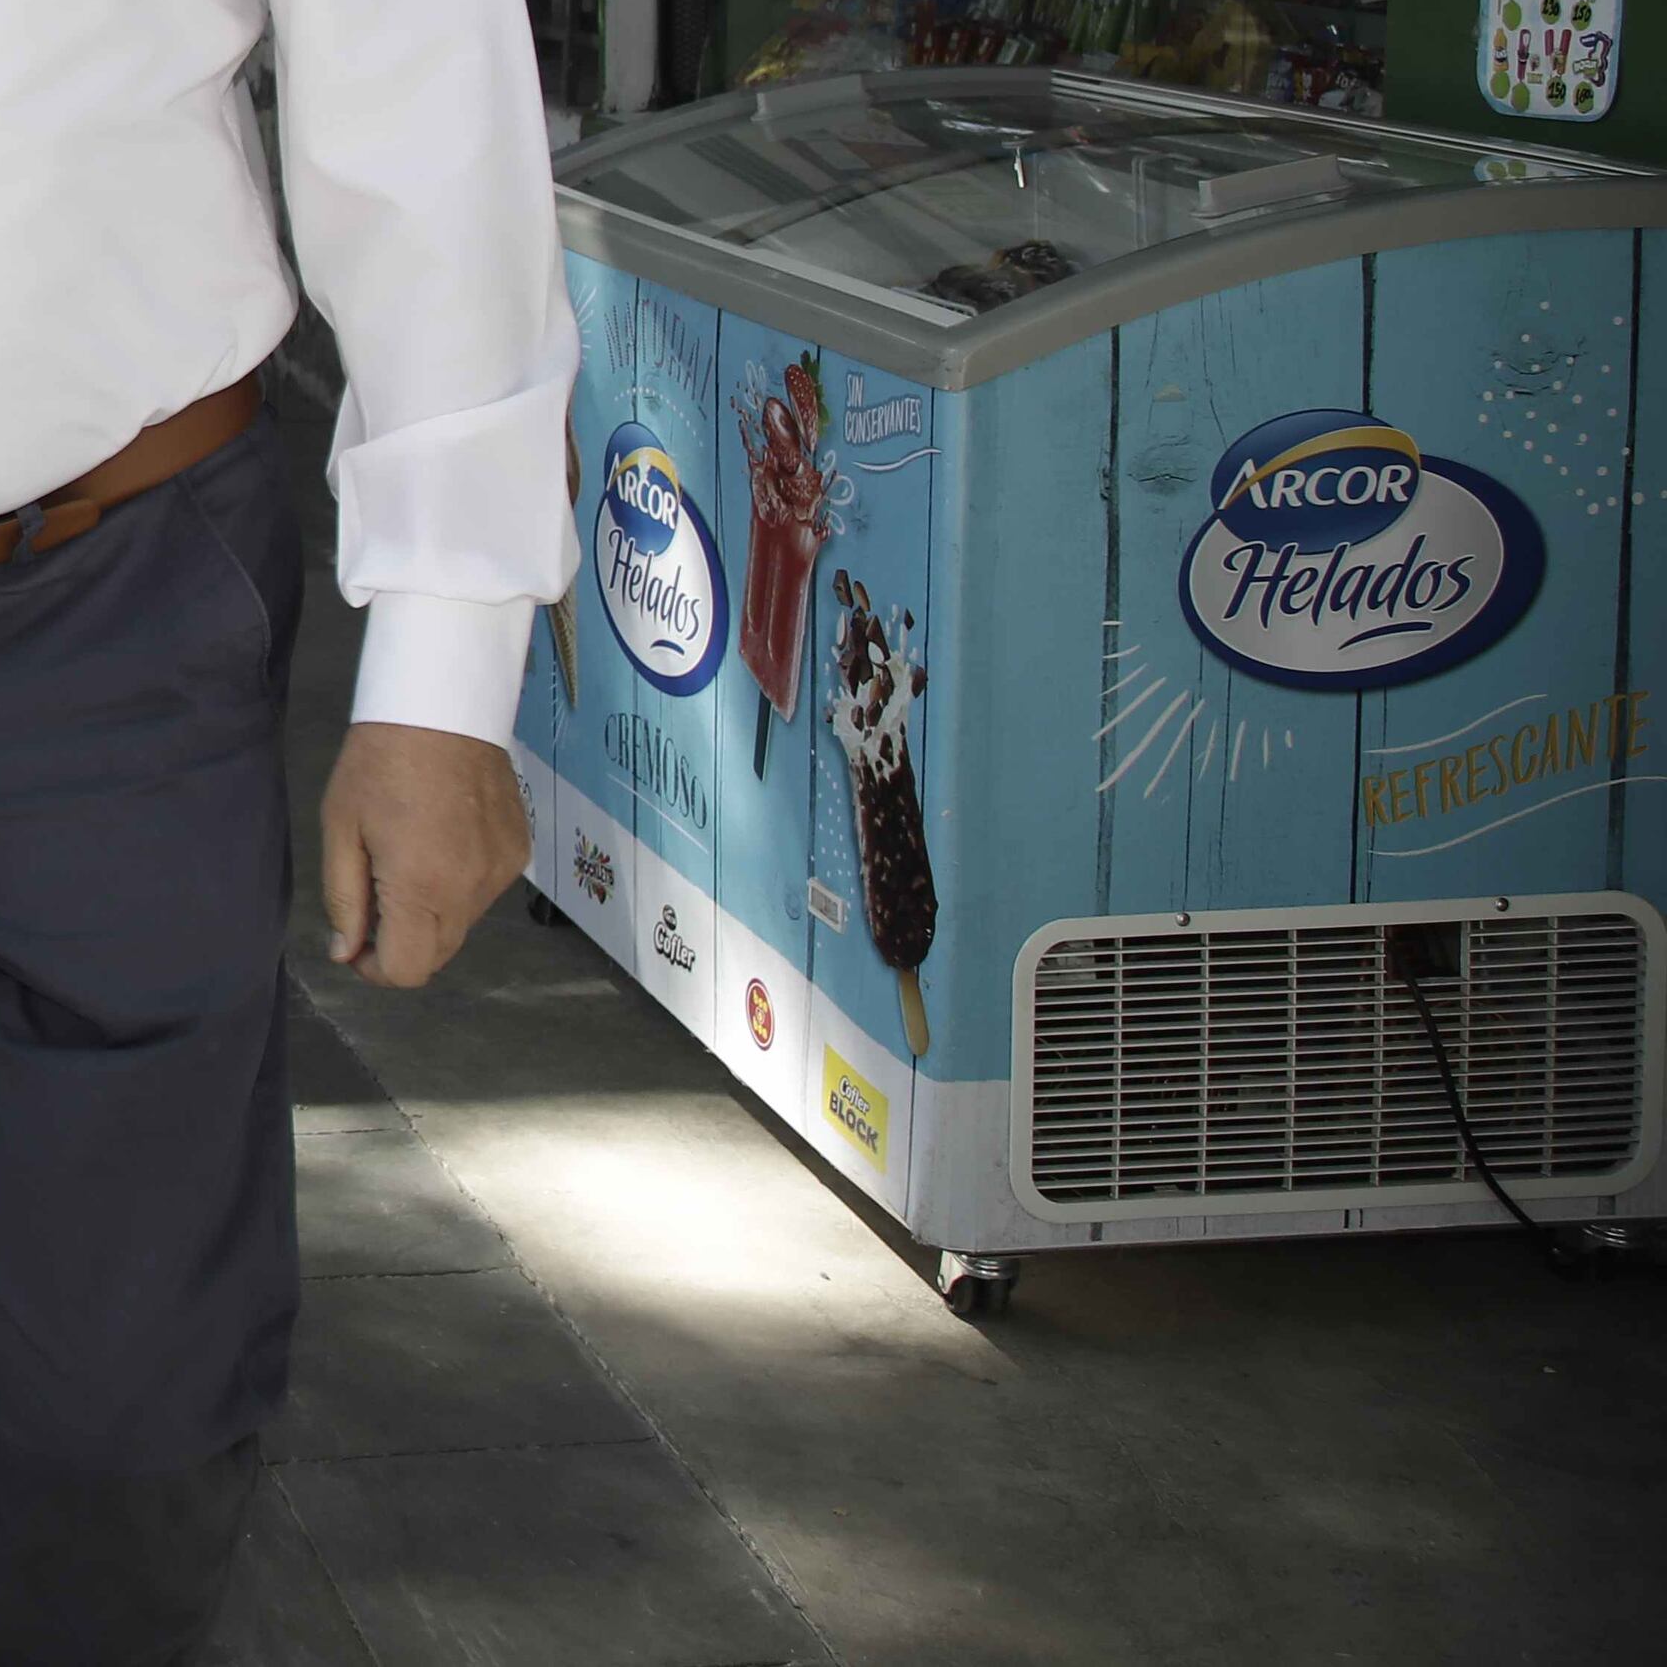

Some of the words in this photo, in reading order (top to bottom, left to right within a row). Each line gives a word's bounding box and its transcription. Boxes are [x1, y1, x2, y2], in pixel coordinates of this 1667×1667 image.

[604, 298, 712, 421] NATURAL
[847, 373, 863, 407] SIN
[844, 397, 921, 444] CONSERVANTES
[606, 452, 676, 530] ARCOR
[1218, 457, 1414, 510] ARCOR
[608, 529, 700, 641] Helados
[1221, 533, 1475, 629] Helados
[604, 712, 707, 830] CREMOSO
[1361, 690, 1652, 827] REFRESCANTE
[654, 921, 696, 973] Cofler
[829, 1090, 879, 1155] BLOCK
[839, 1075, 871, 1116] Cofler
